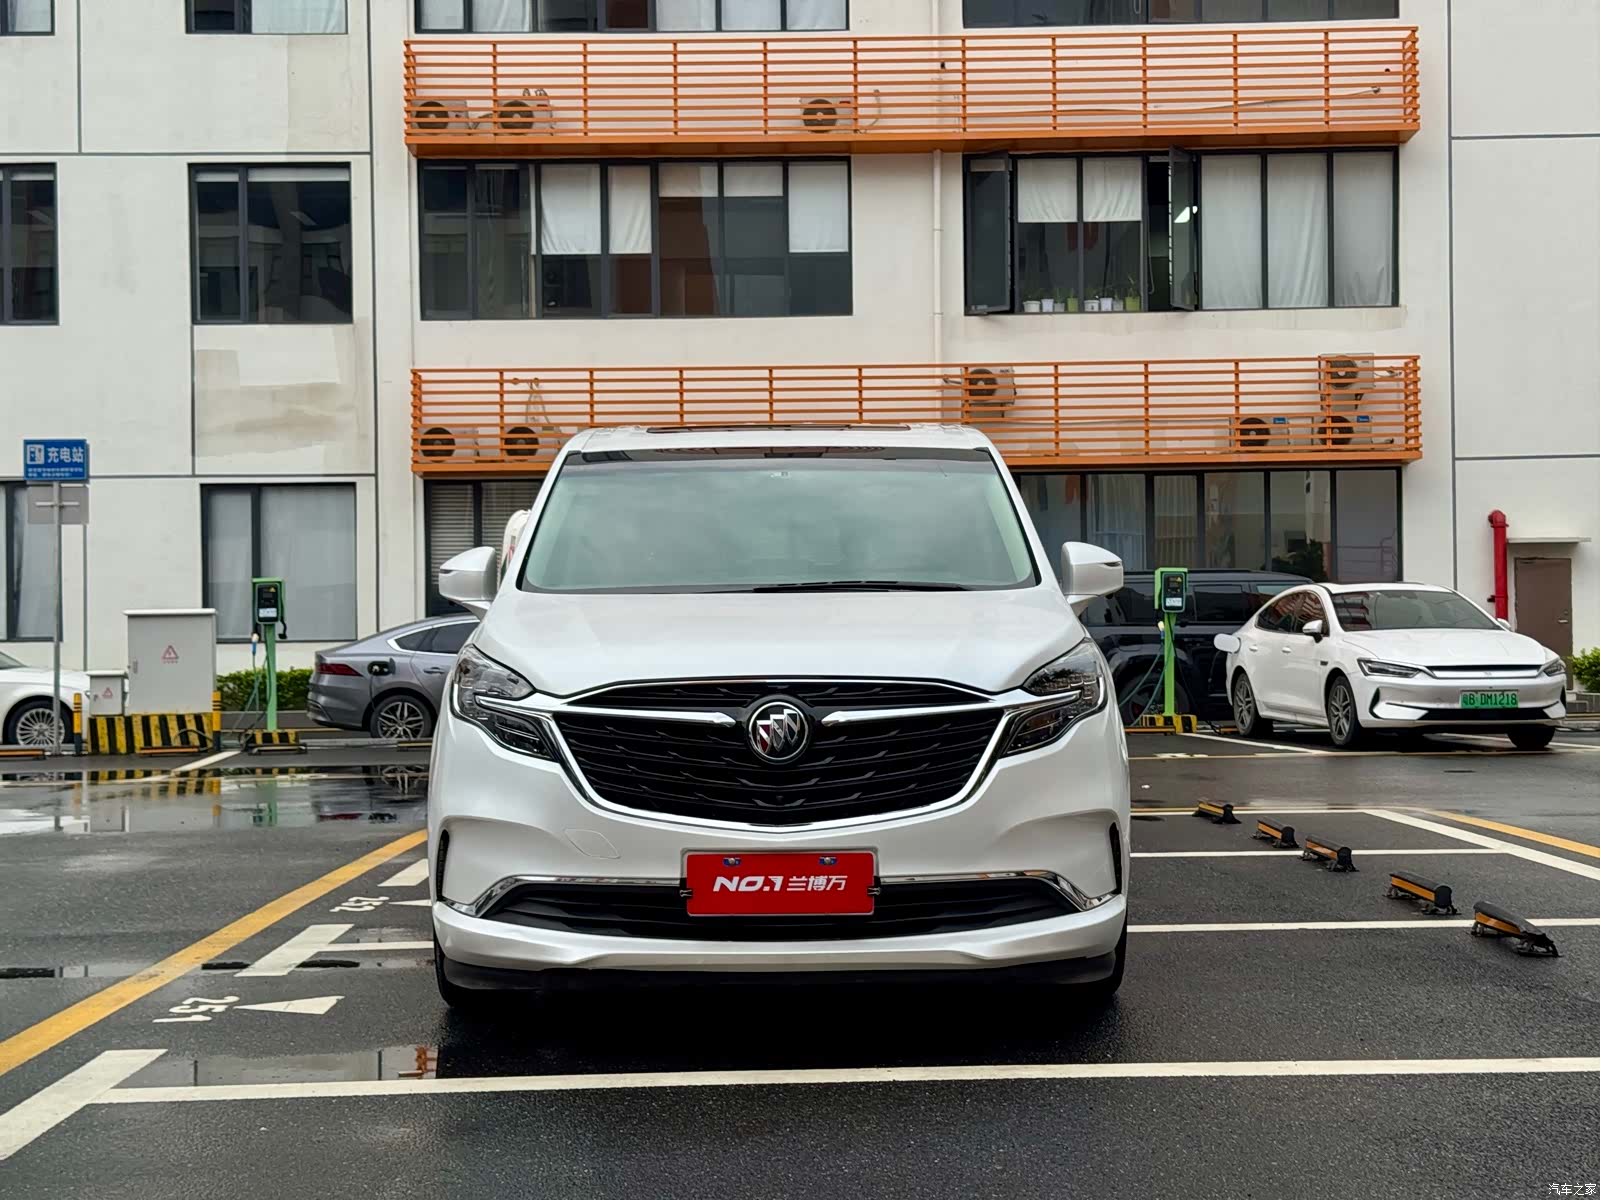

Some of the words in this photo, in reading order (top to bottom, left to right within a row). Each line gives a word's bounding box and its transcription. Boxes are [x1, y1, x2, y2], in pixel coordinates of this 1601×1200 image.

[47, 446, 84, 463] 充电站
[786, 875, 848, 892] 兰博万
[329, 896, 390, 912] 252
[152, 995, 240, 1023] 251
